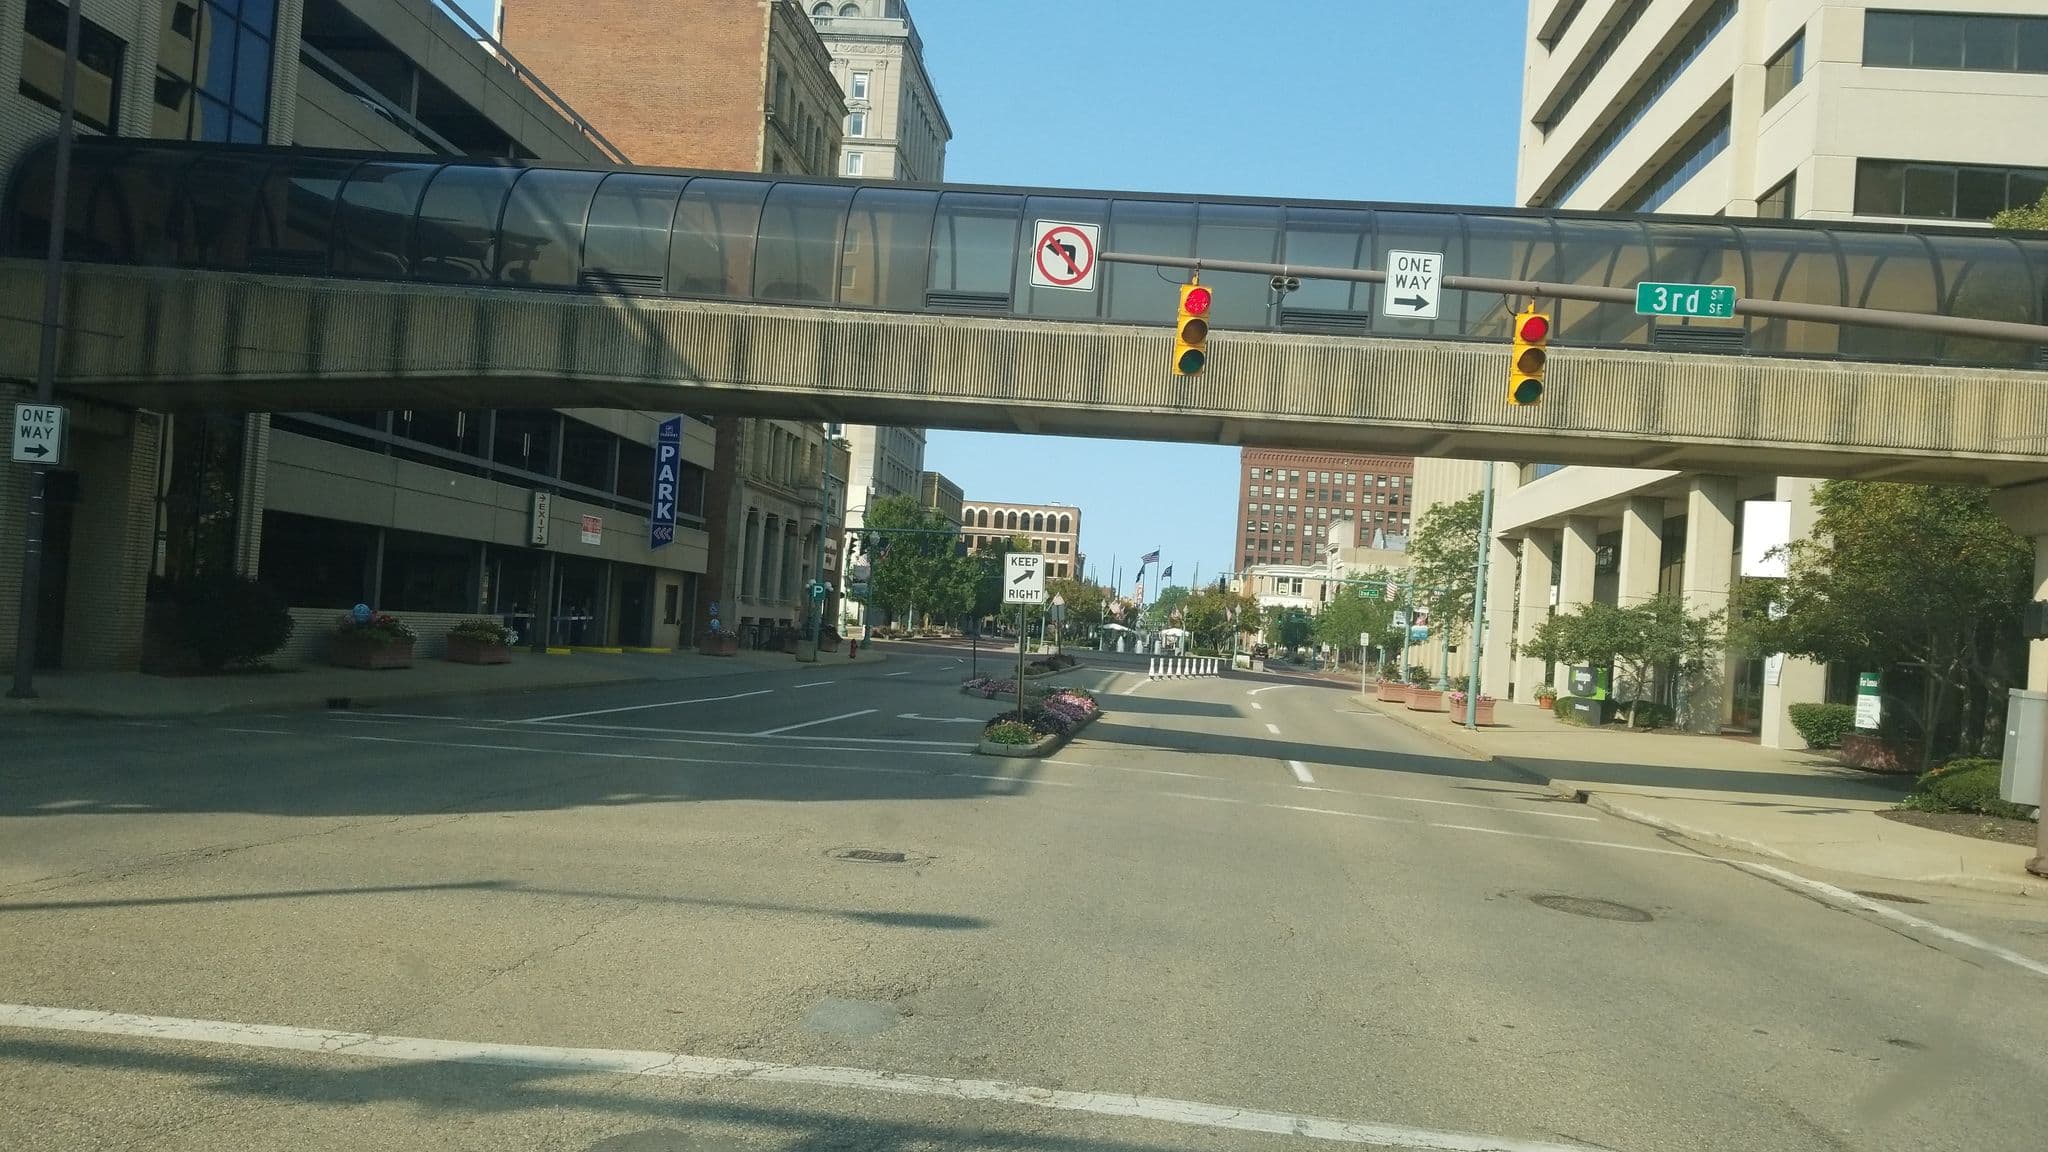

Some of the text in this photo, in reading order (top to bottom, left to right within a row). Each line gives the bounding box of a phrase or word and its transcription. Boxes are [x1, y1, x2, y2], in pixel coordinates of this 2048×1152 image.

[1398, 256, 1432, 273] ONE
[1395, 274, 1432, 290] WAY
[1652, 287, 1725, 313] 3rd ST
[1709, 303, 1724, 315] SE
[22, 408, 55, 423] ONE
[21, 425, 54, 440] WAY
[656, 445, 676, 520] PARK
[537, 503, 546, 533] EXIT
[1011, 557, 1039, 567] KEEP
[813, 585, 824, 597] P
[1008, 589, 1041, 600] RIGHT
